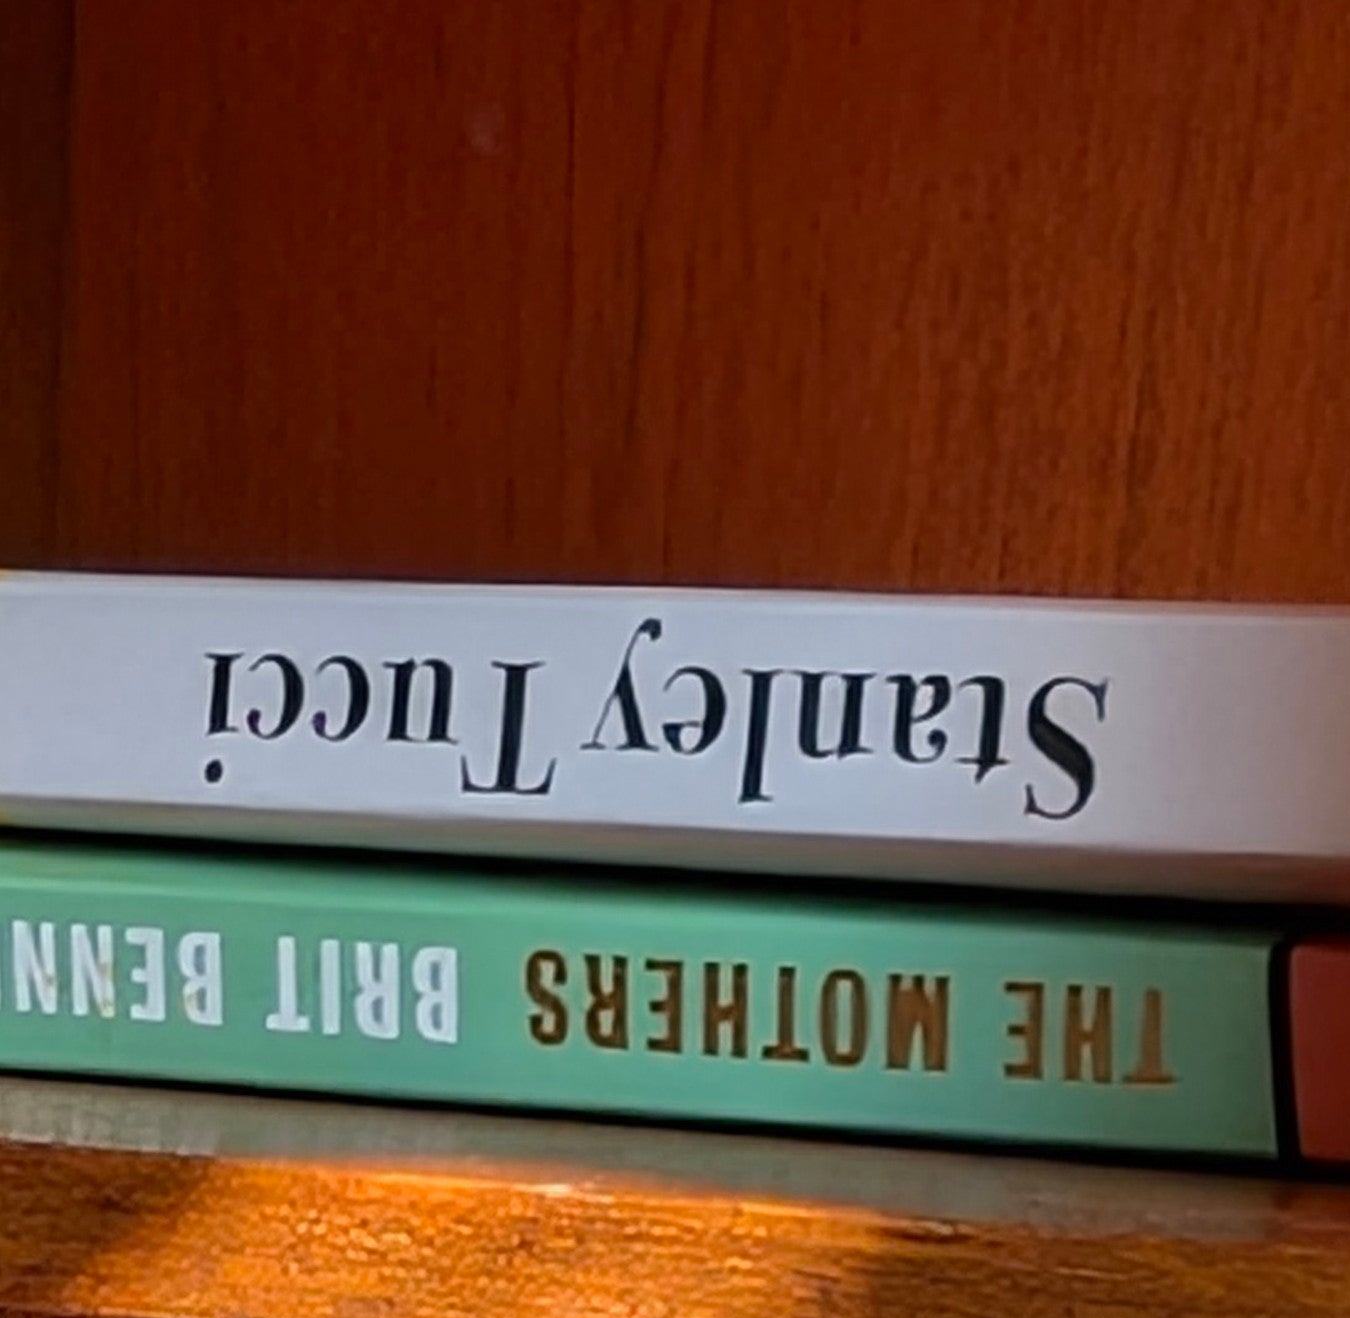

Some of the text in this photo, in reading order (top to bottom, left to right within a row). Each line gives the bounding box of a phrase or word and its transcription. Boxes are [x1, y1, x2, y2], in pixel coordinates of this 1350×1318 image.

[204, 617, 1111, 820] Stanley Tucci
[265, 935, 458, 1044] BRIT
[524, 948, 952, 1072] MOTHERS
[1002, 980, 1183, 1084] THE
